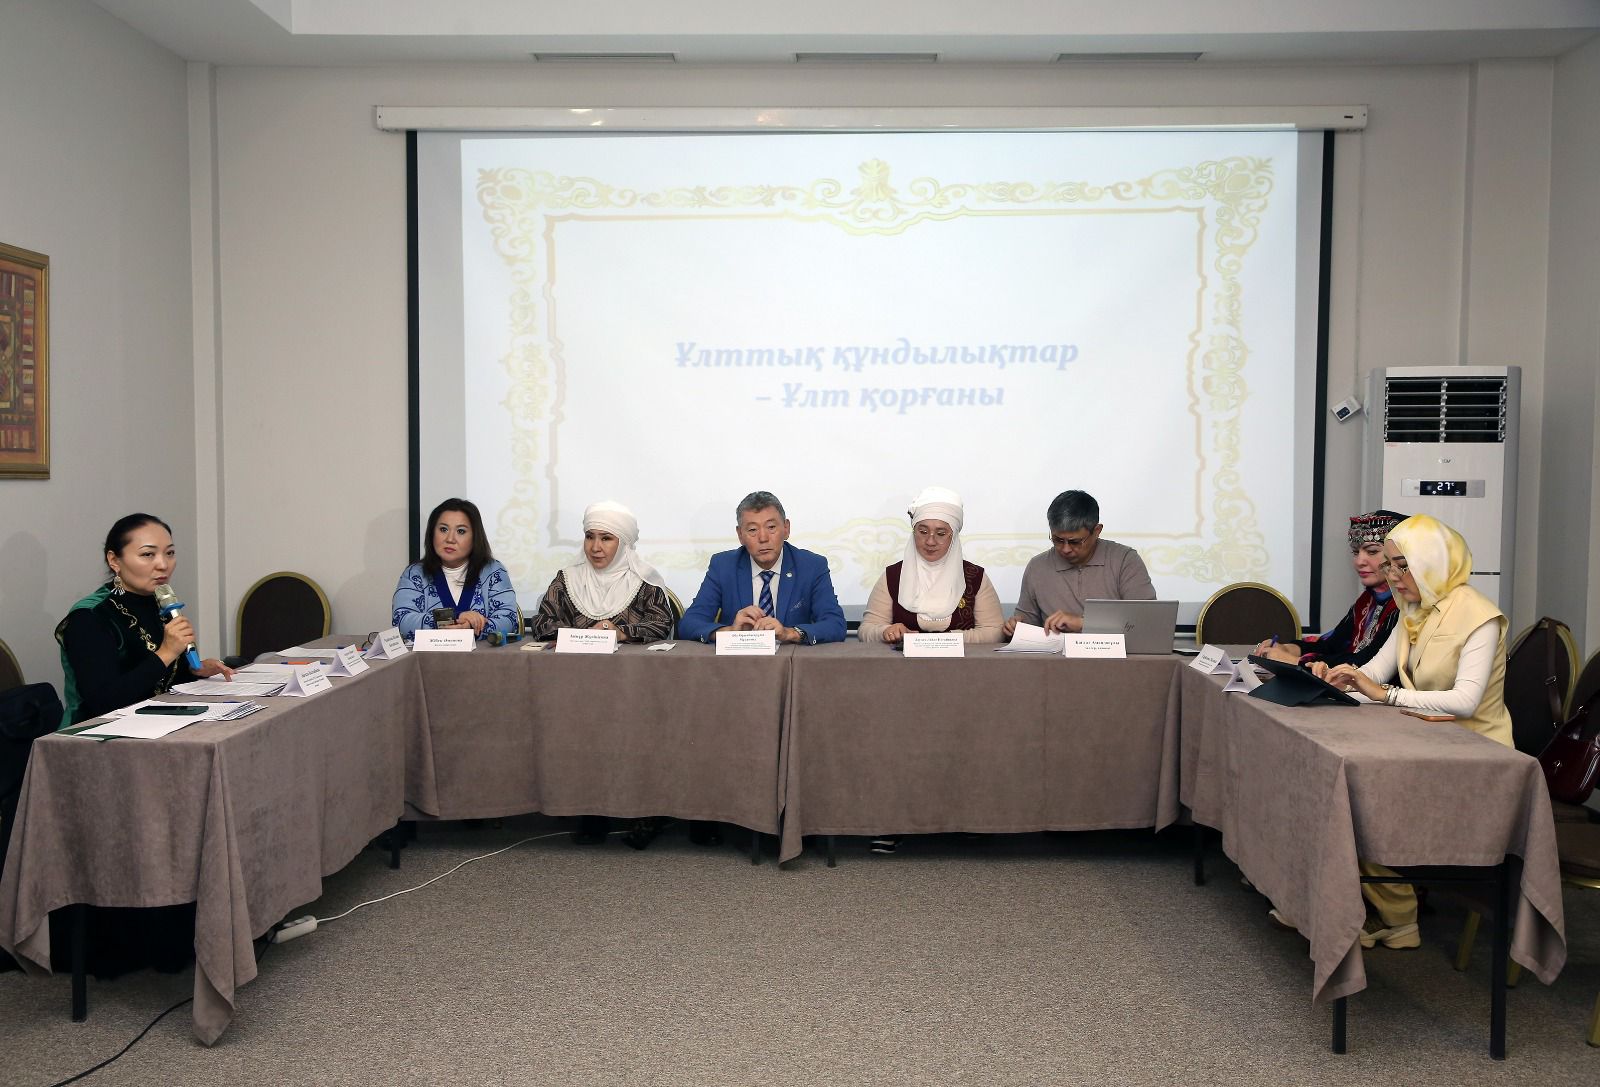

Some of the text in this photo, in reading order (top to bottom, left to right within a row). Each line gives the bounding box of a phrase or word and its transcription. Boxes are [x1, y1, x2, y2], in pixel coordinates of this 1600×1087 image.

[675, 337, 1080, 373] Ұлттық құндылықтар
[781, 382, 851, 409] Ұлт
[858, 386, 1006, 415] қорғаны
